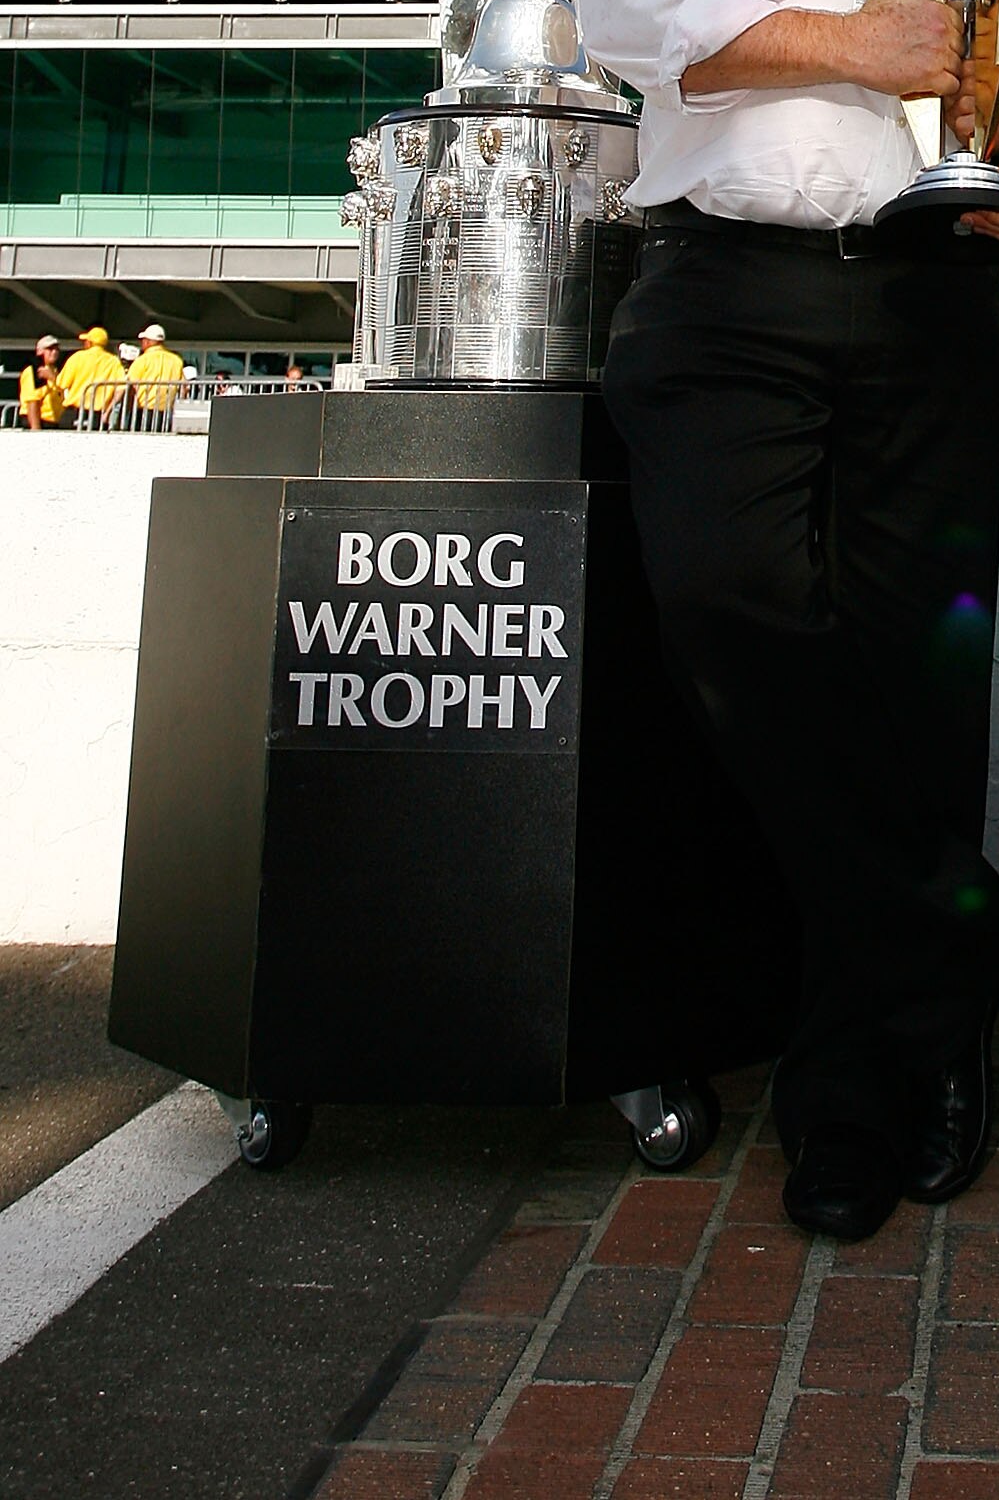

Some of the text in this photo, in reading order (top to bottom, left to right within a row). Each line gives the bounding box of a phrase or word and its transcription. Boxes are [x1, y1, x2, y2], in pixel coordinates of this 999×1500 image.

[336, 531, 526, 588] BORG
[287, 600, 569, 658] WARNER
[288, 671, 562, 729] TROPHY
